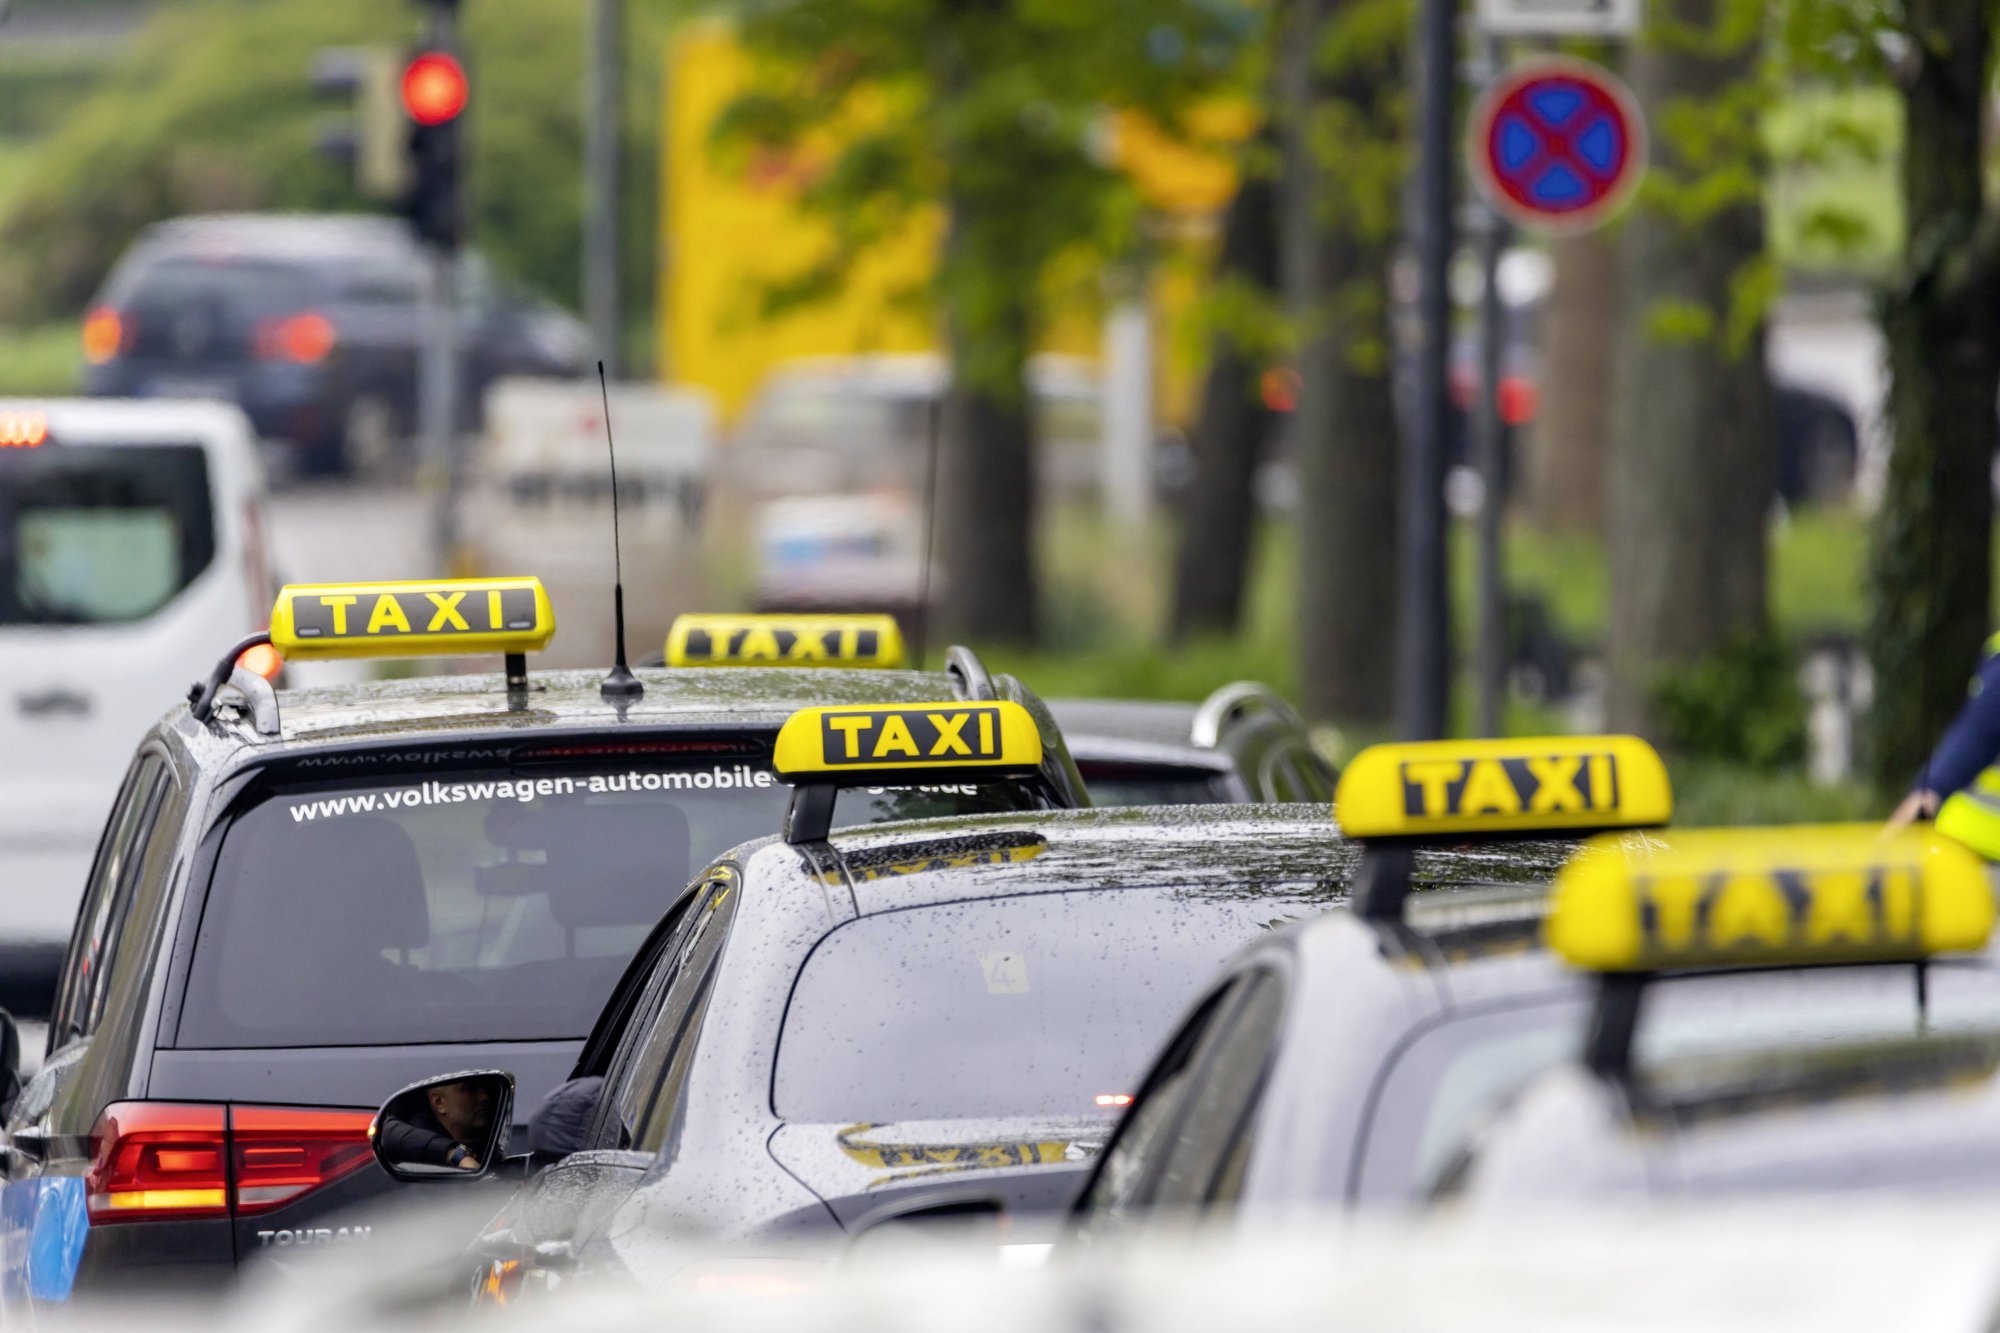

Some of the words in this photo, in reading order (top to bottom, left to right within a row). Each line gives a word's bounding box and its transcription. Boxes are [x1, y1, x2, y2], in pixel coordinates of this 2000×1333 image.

[320, 590, 503, 635] TAXI
[702, 629, 860, 661] TAXI
[829, 712, 994, 758] TAXI
[1405, 755, 1614, 817] TAXI
[1647, 868, 1913, 948] TAXI
[257, 1226, 371, 1246] TOURAN
